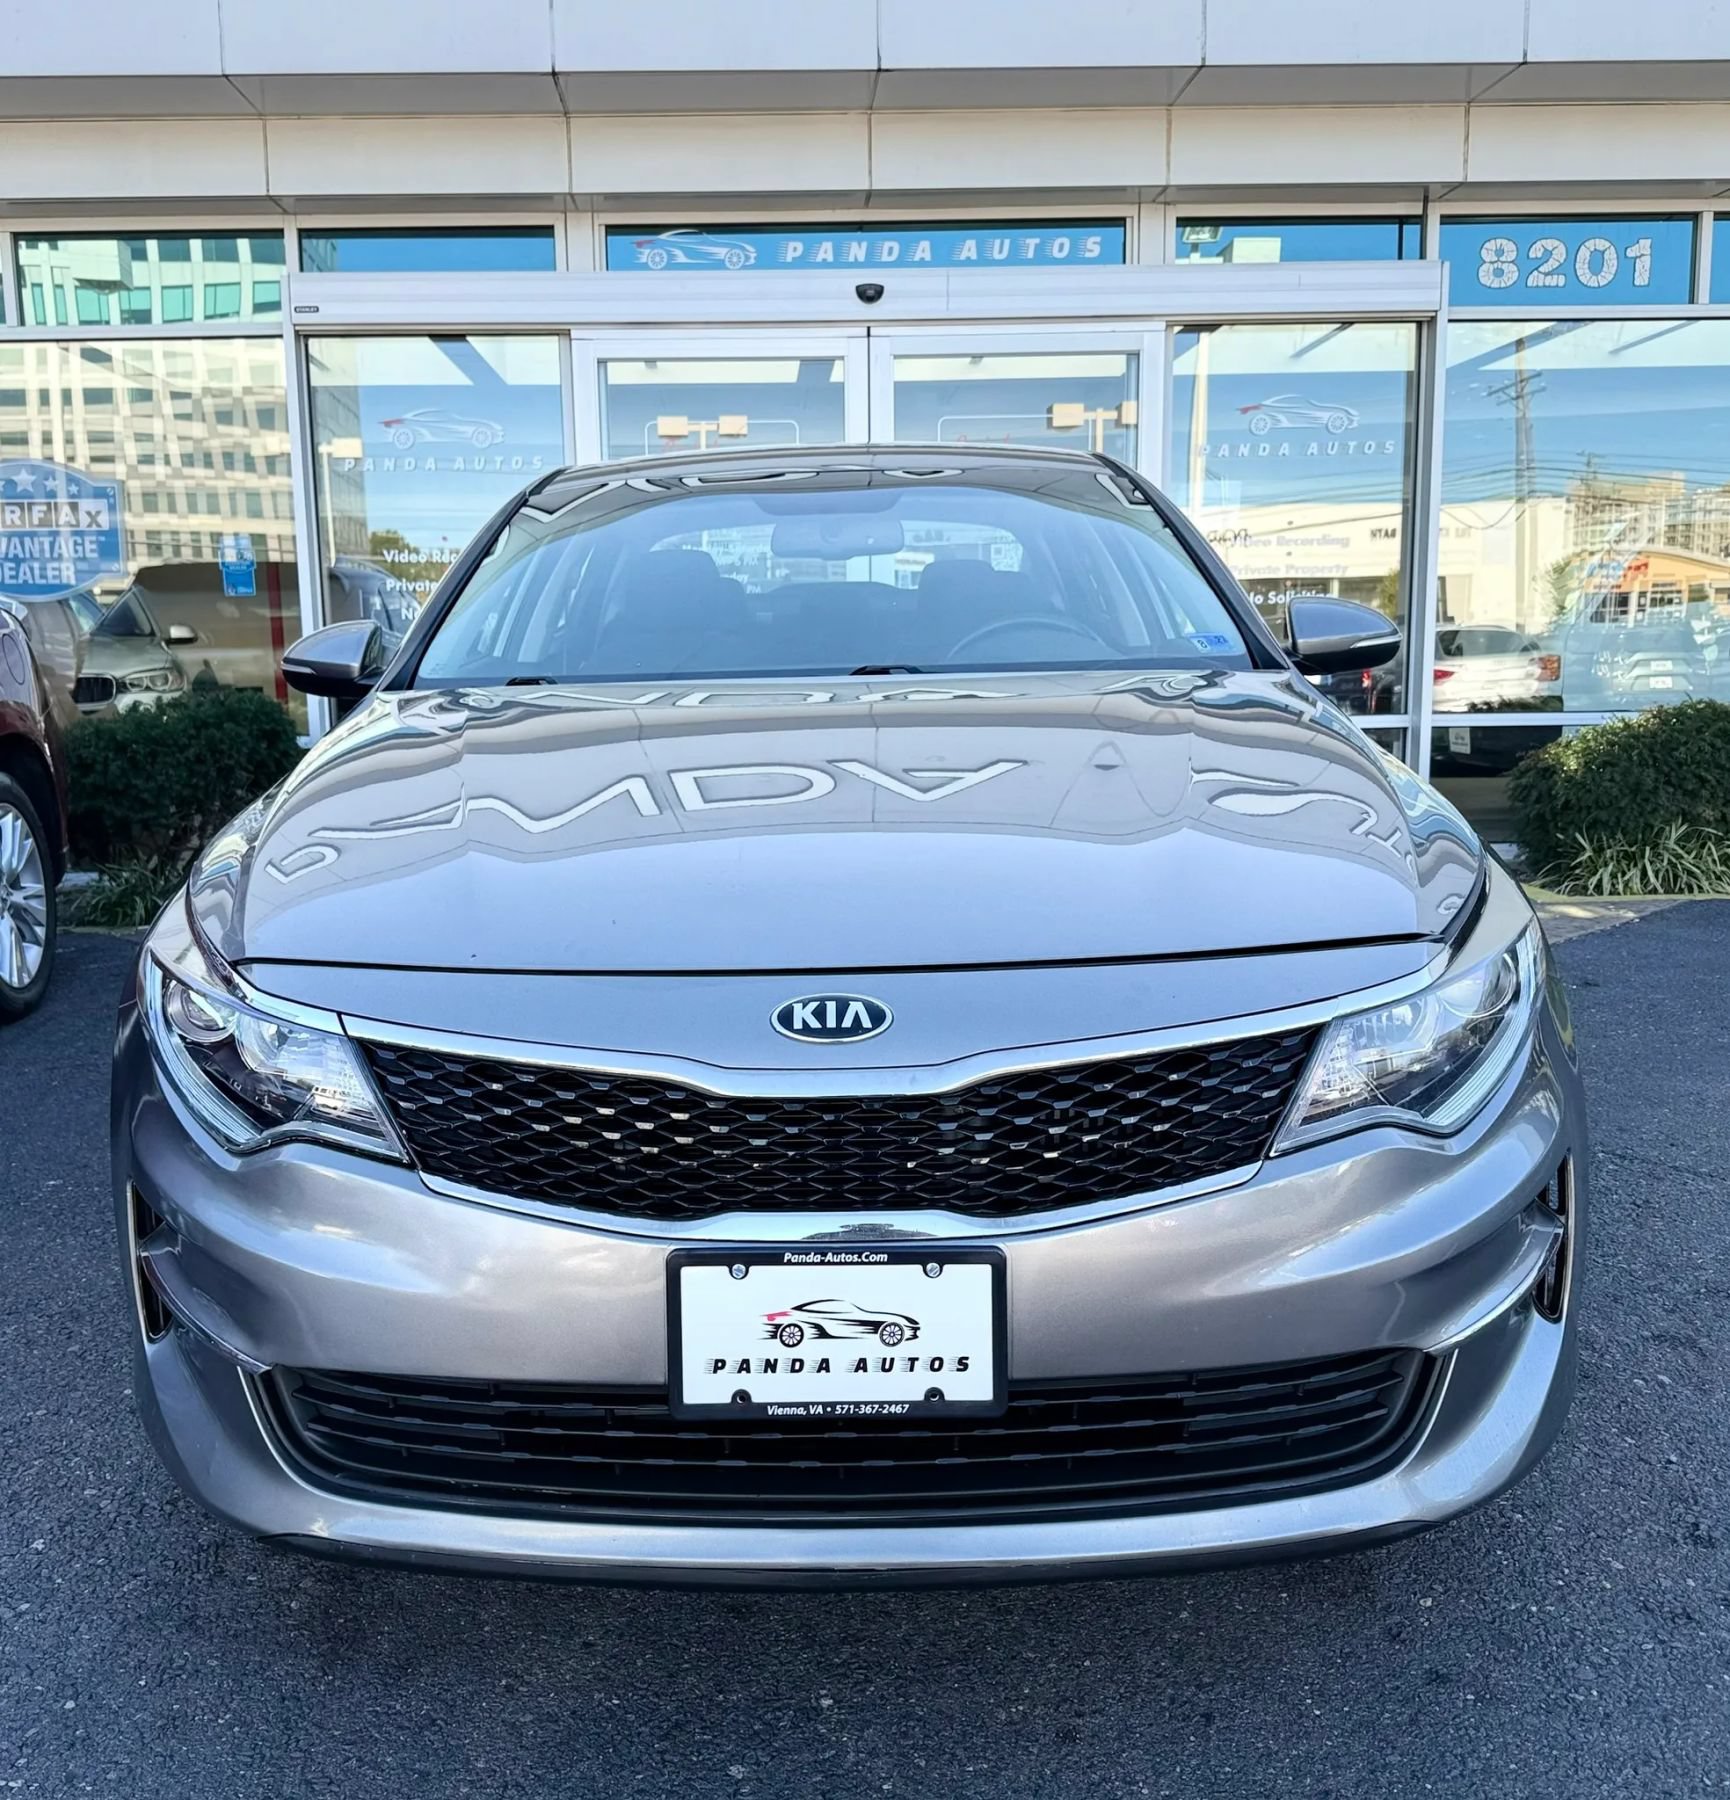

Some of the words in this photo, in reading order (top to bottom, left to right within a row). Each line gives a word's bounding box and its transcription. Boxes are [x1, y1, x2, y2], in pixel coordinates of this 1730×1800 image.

[784, 240, 931, 262] PANDA
[958, 236, 1102, 260] AUTOS
[1477, 237, 1653, 289] 8201
[1200, 443, 1289, 458] PANDA
[1307, 441, 1395, 456] AUTOS
[343, 456, 438, 472] PANDA
[453, 455, 545, 470] AUTOS
[1276, 534, 1349, 548] Recording
[383, 549, 427, 563] Video
[0, 561, 76, 585] EALER
[1285, 565, 1349, 576] Property
[792, 1001, 873, 1030] KIA
[783, 1252, 888, 1263] Panda-Autos.Com
[710, 1358, 831, 1374] PANDA
[852, 1356, 970, 1373] AUTOS
[767, 1405, 807, 1415] Vienna,
[809, 1405, 824, 1415] VA
[835, 1404, 910, 1414] 571-367-2467
